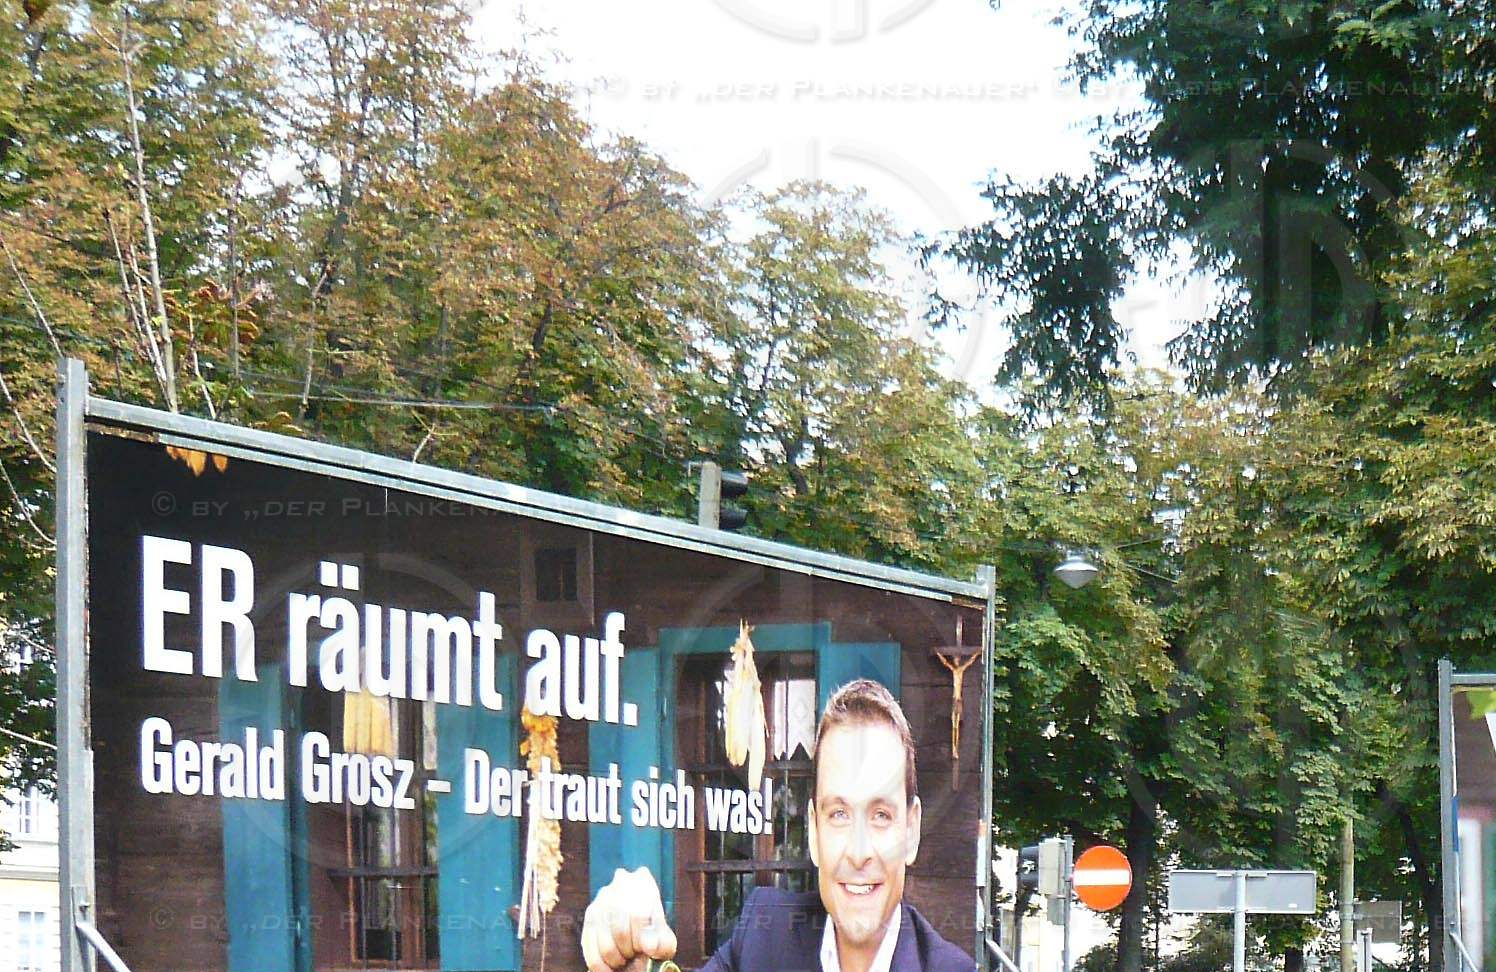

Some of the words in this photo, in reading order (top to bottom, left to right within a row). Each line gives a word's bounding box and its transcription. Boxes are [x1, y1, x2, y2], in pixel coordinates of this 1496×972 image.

[141, 535, 257, 682] ER
[288, 561, 503, 711] räumt
[525, 611, 639, 726] auf.
[141, 716, 285, 801] Gerald
[301, 731, 415, 809] Grosz
[465, 748, 527, 817] Der
[539, 757, 621, 825] traut
[631, 766, 695, 830] sich
[705, 777, 773, 835] was!
